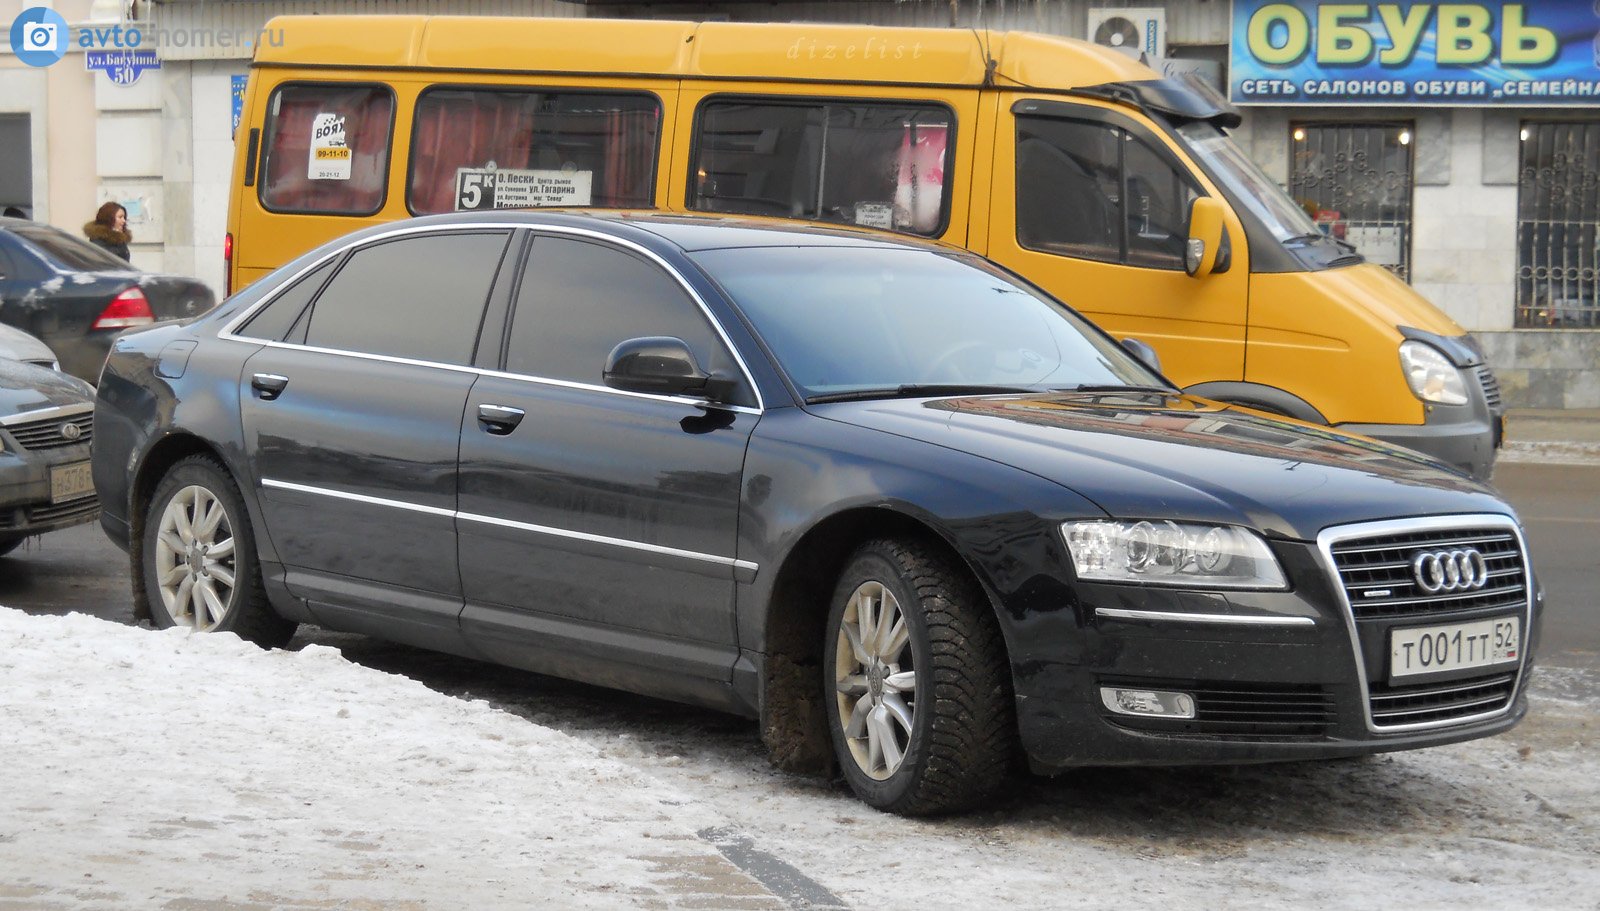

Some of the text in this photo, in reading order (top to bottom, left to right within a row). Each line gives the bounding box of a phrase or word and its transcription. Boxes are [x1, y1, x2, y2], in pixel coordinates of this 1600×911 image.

[1247, 3, 1557, 64] ОБУВЬ
[114, 67, 134, 83] 50
[1242, 80, 1296, 95] СЕТЬ
[1303, 80, 1406, 95] САЛОНОВ
[1414, 80, 1485, 96] ОБУВИ
[318, 150, 348, 158] 99-11-10
[507, 174, 534, 184] Пески
[529, 185, 540, 194] ул.
[541, 185, 576, 194] Гагарина
[1495, 622, 1513, 648] 52
